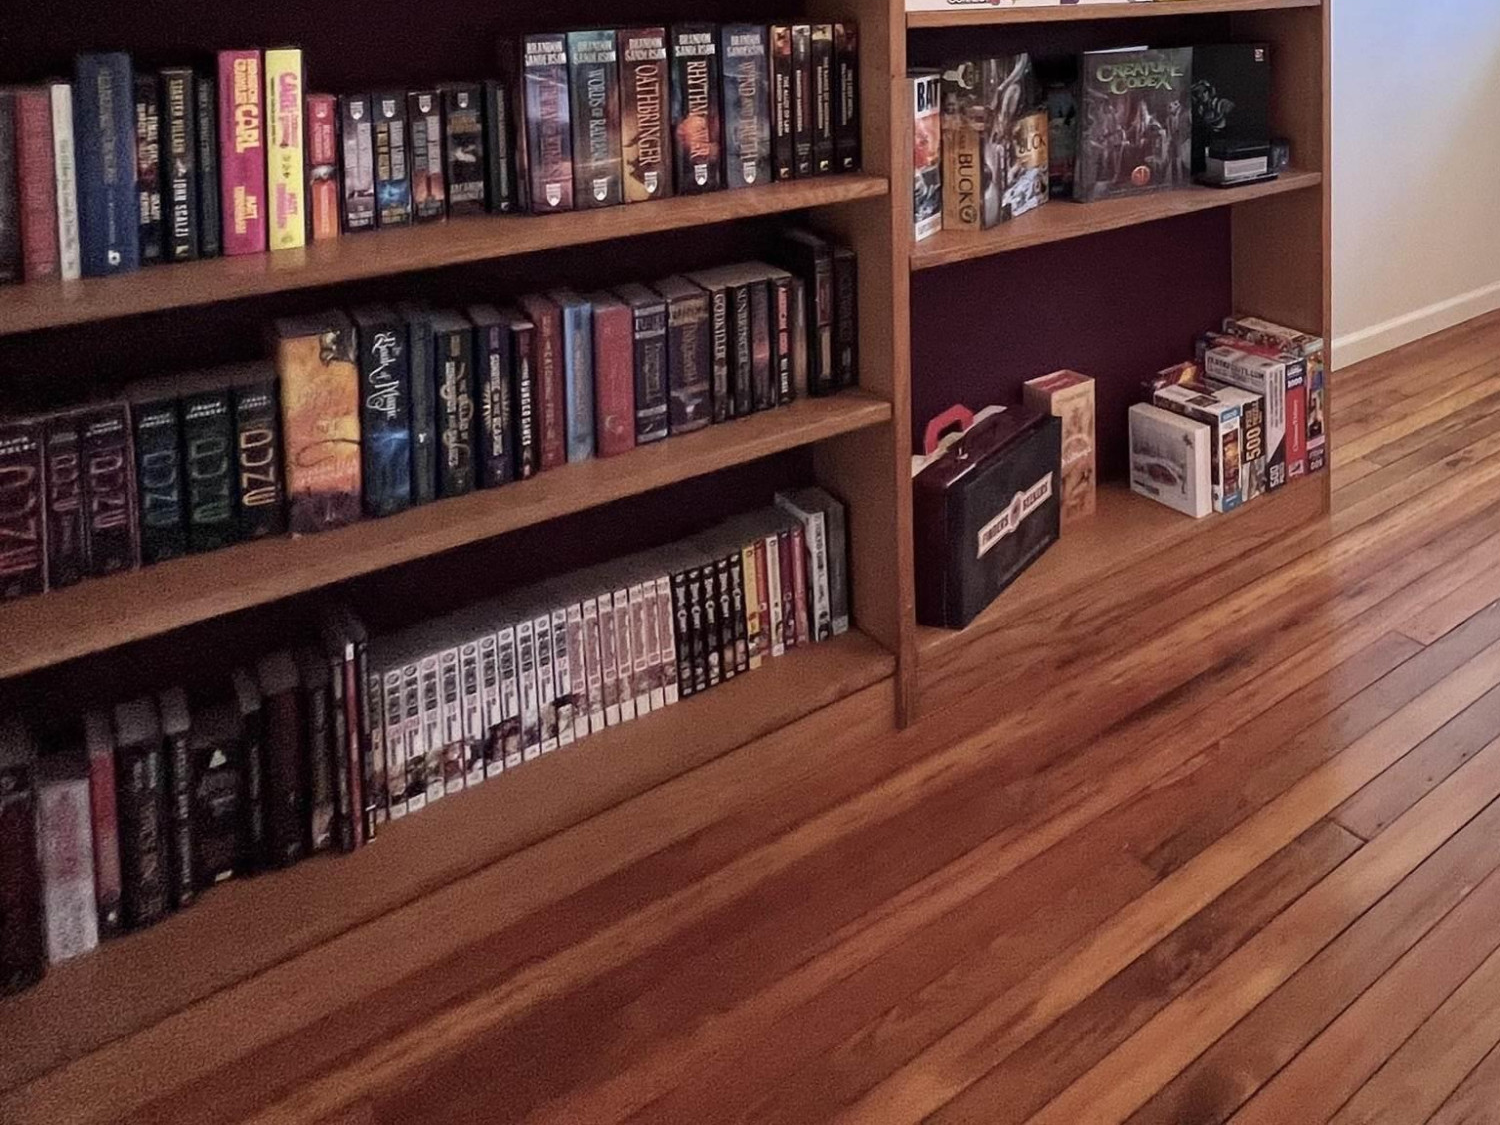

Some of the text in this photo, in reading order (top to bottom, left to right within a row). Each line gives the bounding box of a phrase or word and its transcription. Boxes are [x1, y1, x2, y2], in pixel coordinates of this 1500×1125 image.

[588, 68, 606, 107] WORDS
[686, 60, 709, 115] RHYTHM
[738, 61, 758, 96] WIND
[1096, 61, 1185, 83] CREATURE
[1110, 75, 1173, 96] CODEX
[235, 103, 260, 153] CARL
[634, 63, 662, 167] OATHBRINGER
[739, 116, 758, 160] TRUTH
[173, 179, 187, 202] JOHN
[958, 153, 974, 204] BUCK
[174, 204, 188, 237] SCALZI
[714, 293, 727, 361] GODKILLER
[366, 380, 400, 421] Magic
[520, 380, 531, 446] HUNGER GAMES
[1245, 426, 1262, 461] 500
[240, 428, 276, 507] DUNE
[1270, 464, 1280, 488] 500
